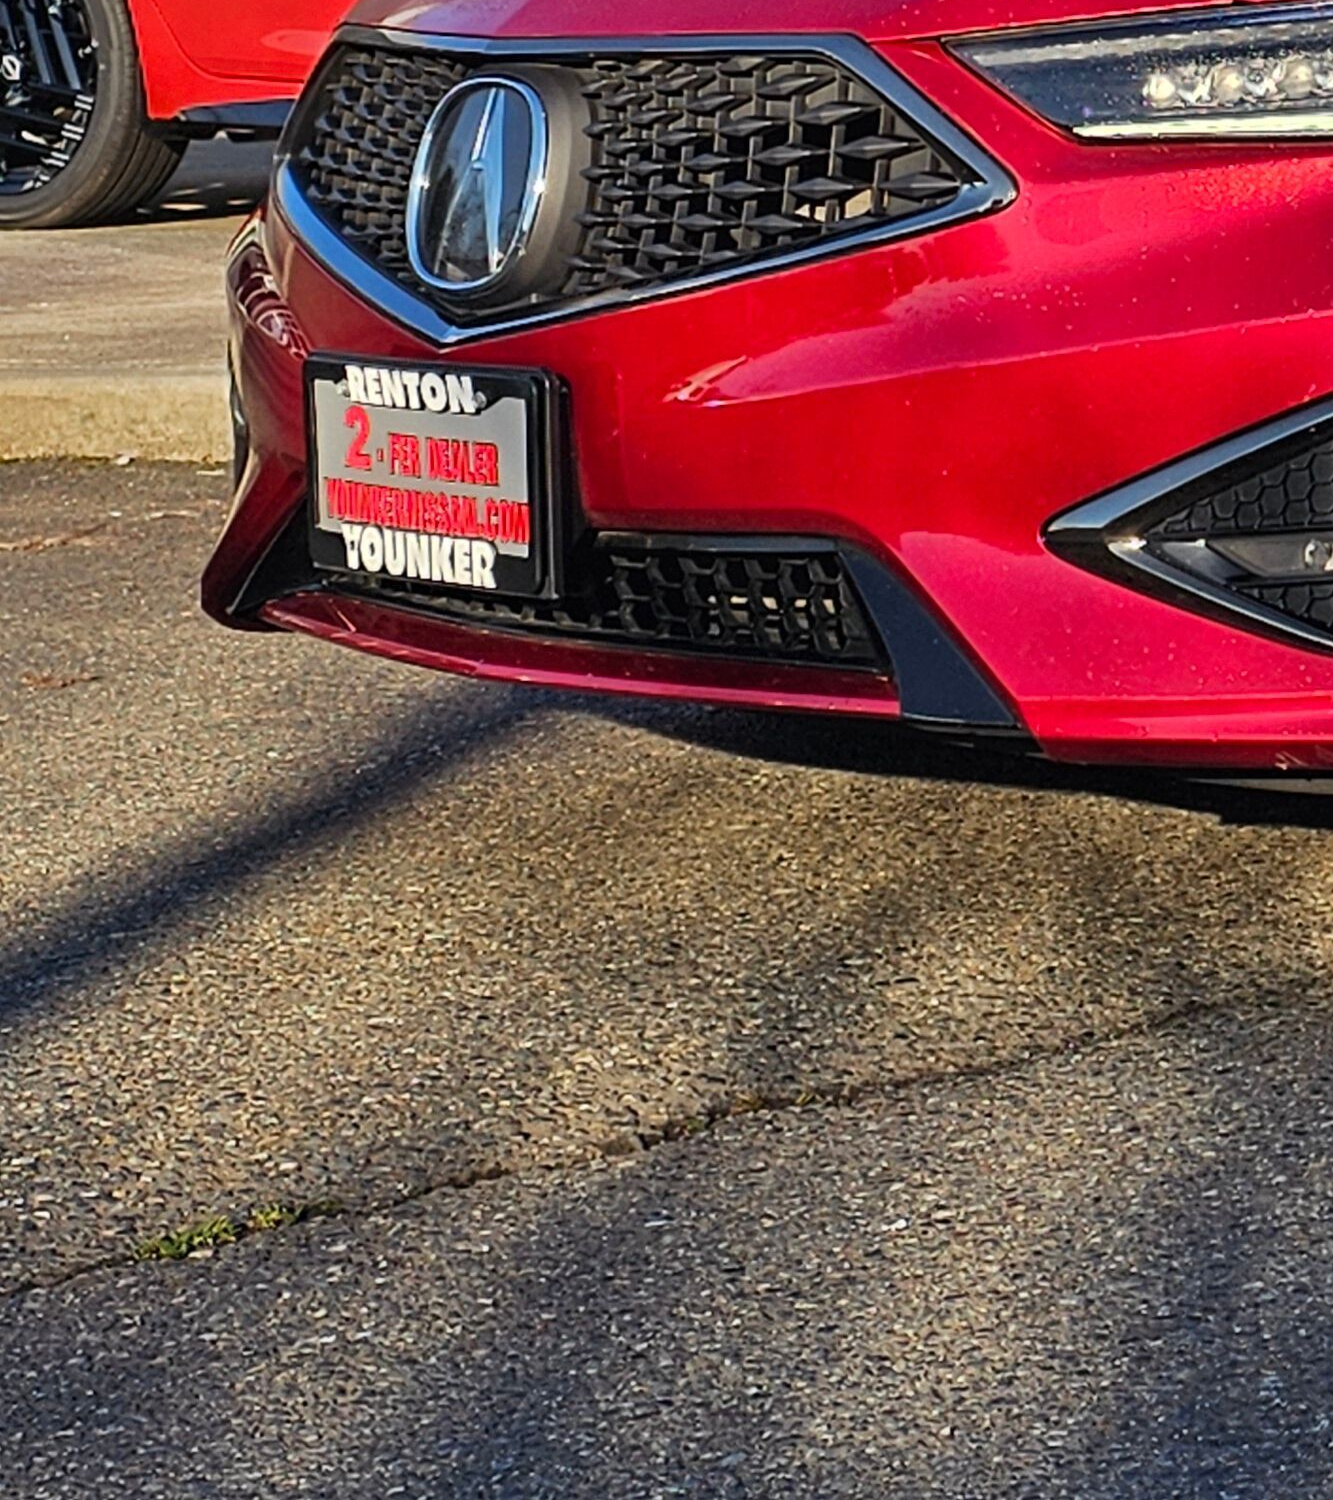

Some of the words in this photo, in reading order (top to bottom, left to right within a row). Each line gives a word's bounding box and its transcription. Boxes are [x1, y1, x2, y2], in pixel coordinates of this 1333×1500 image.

[344, 364, 477, 414] RENTON
[425, 436, 499, 486] DEALER
[340, 523, 497, 590] YOUNKER
